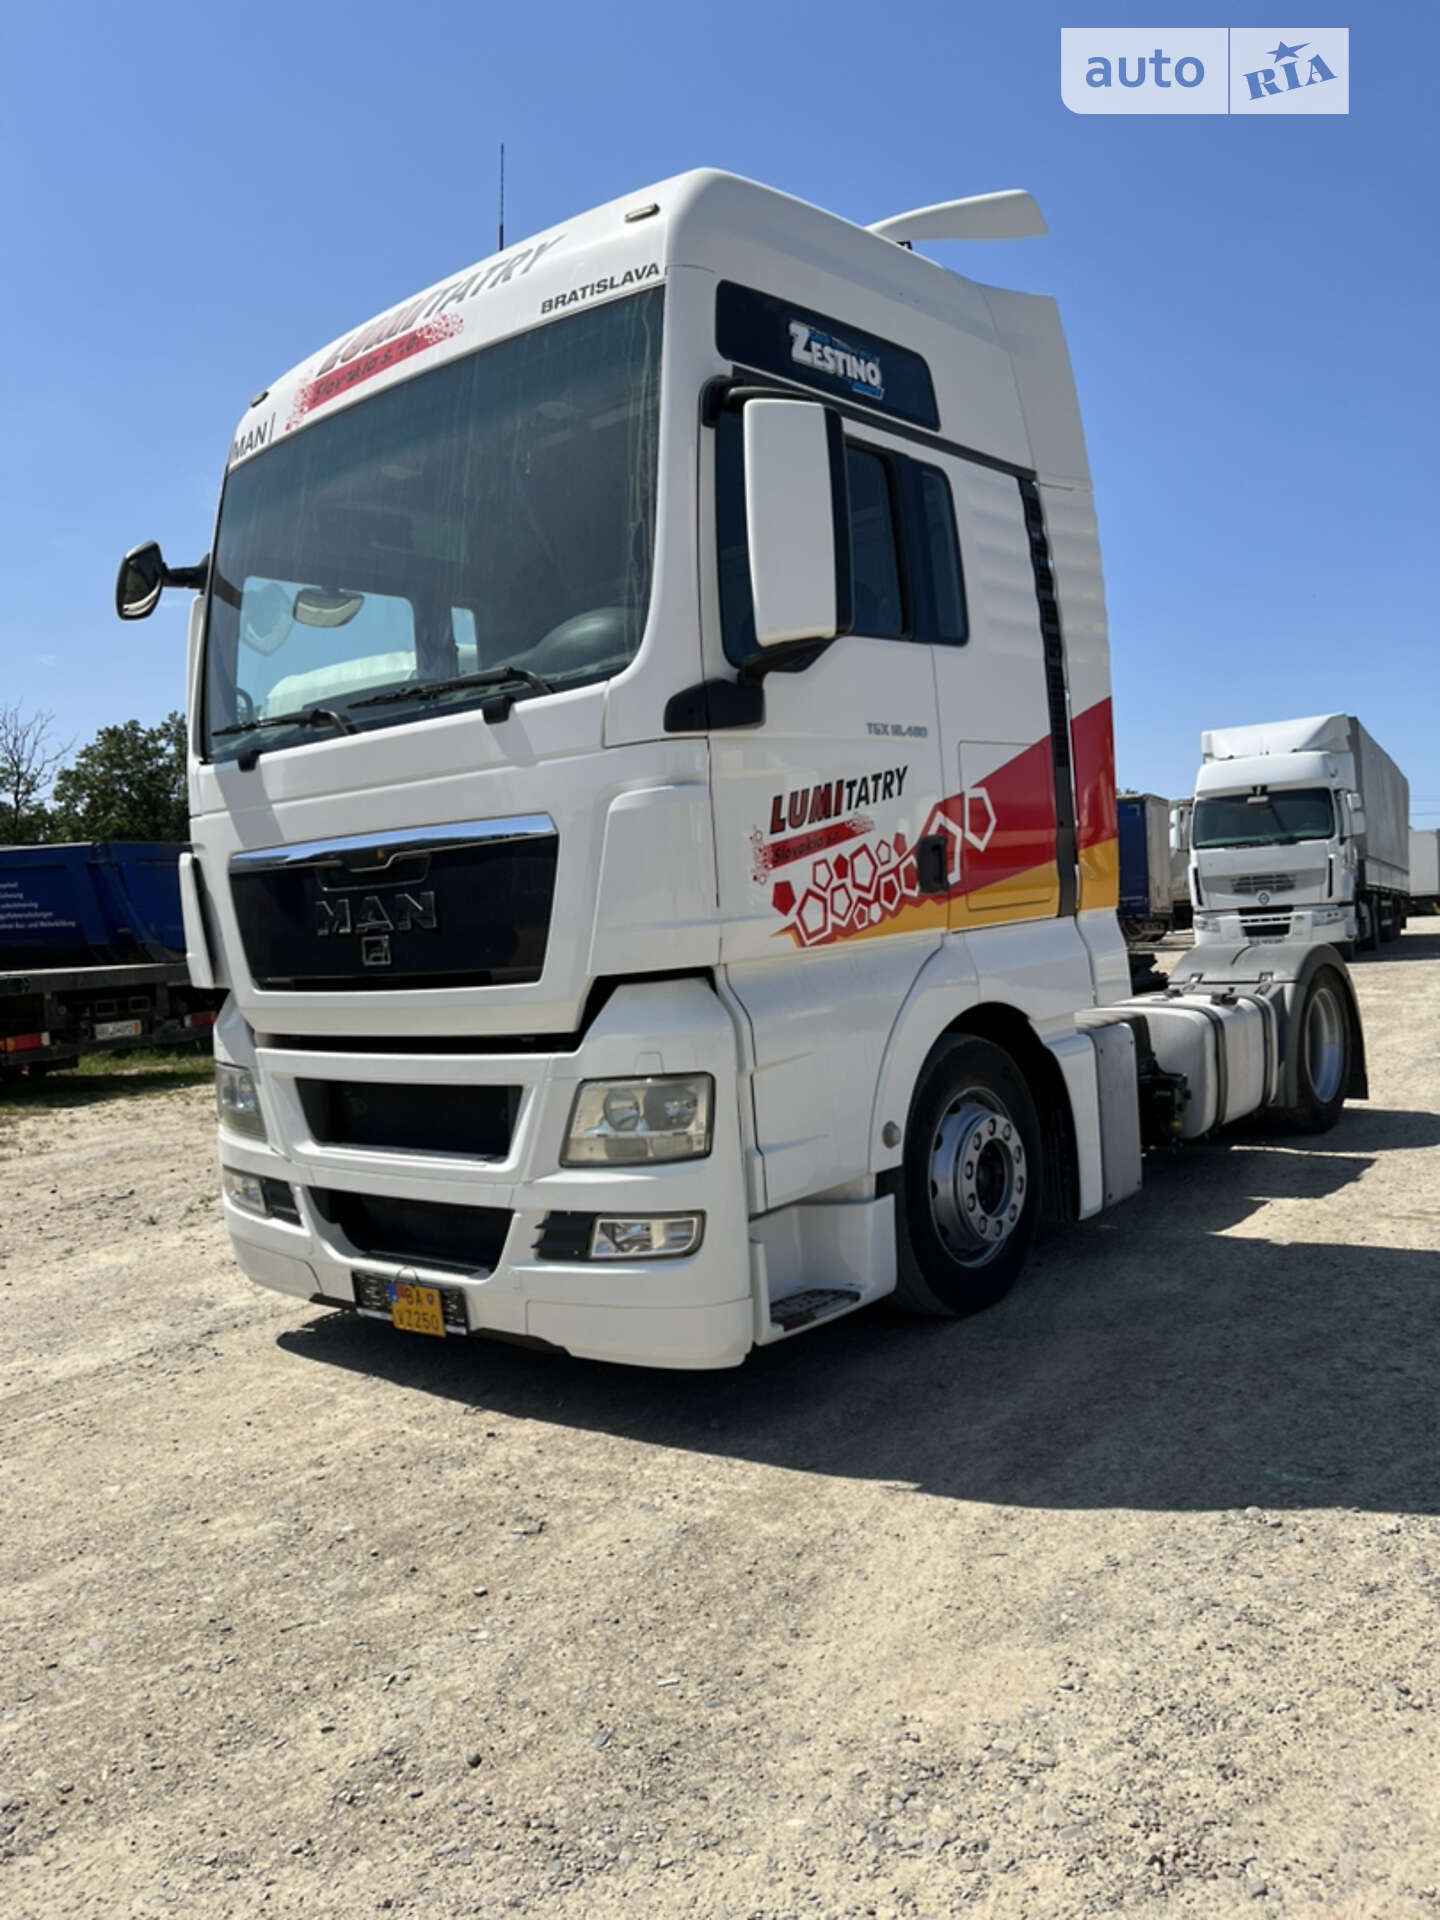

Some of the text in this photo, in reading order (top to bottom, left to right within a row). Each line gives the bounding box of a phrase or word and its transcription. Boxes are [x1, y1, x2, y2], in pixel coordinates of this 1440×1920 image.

[541, 262, 660, 314] BRATISLAVA
[789, 320, 882, 387] ZESTINO
[770, 766, 908, 835] LUMITATRY
[315, 890, 438, 937] MAN
